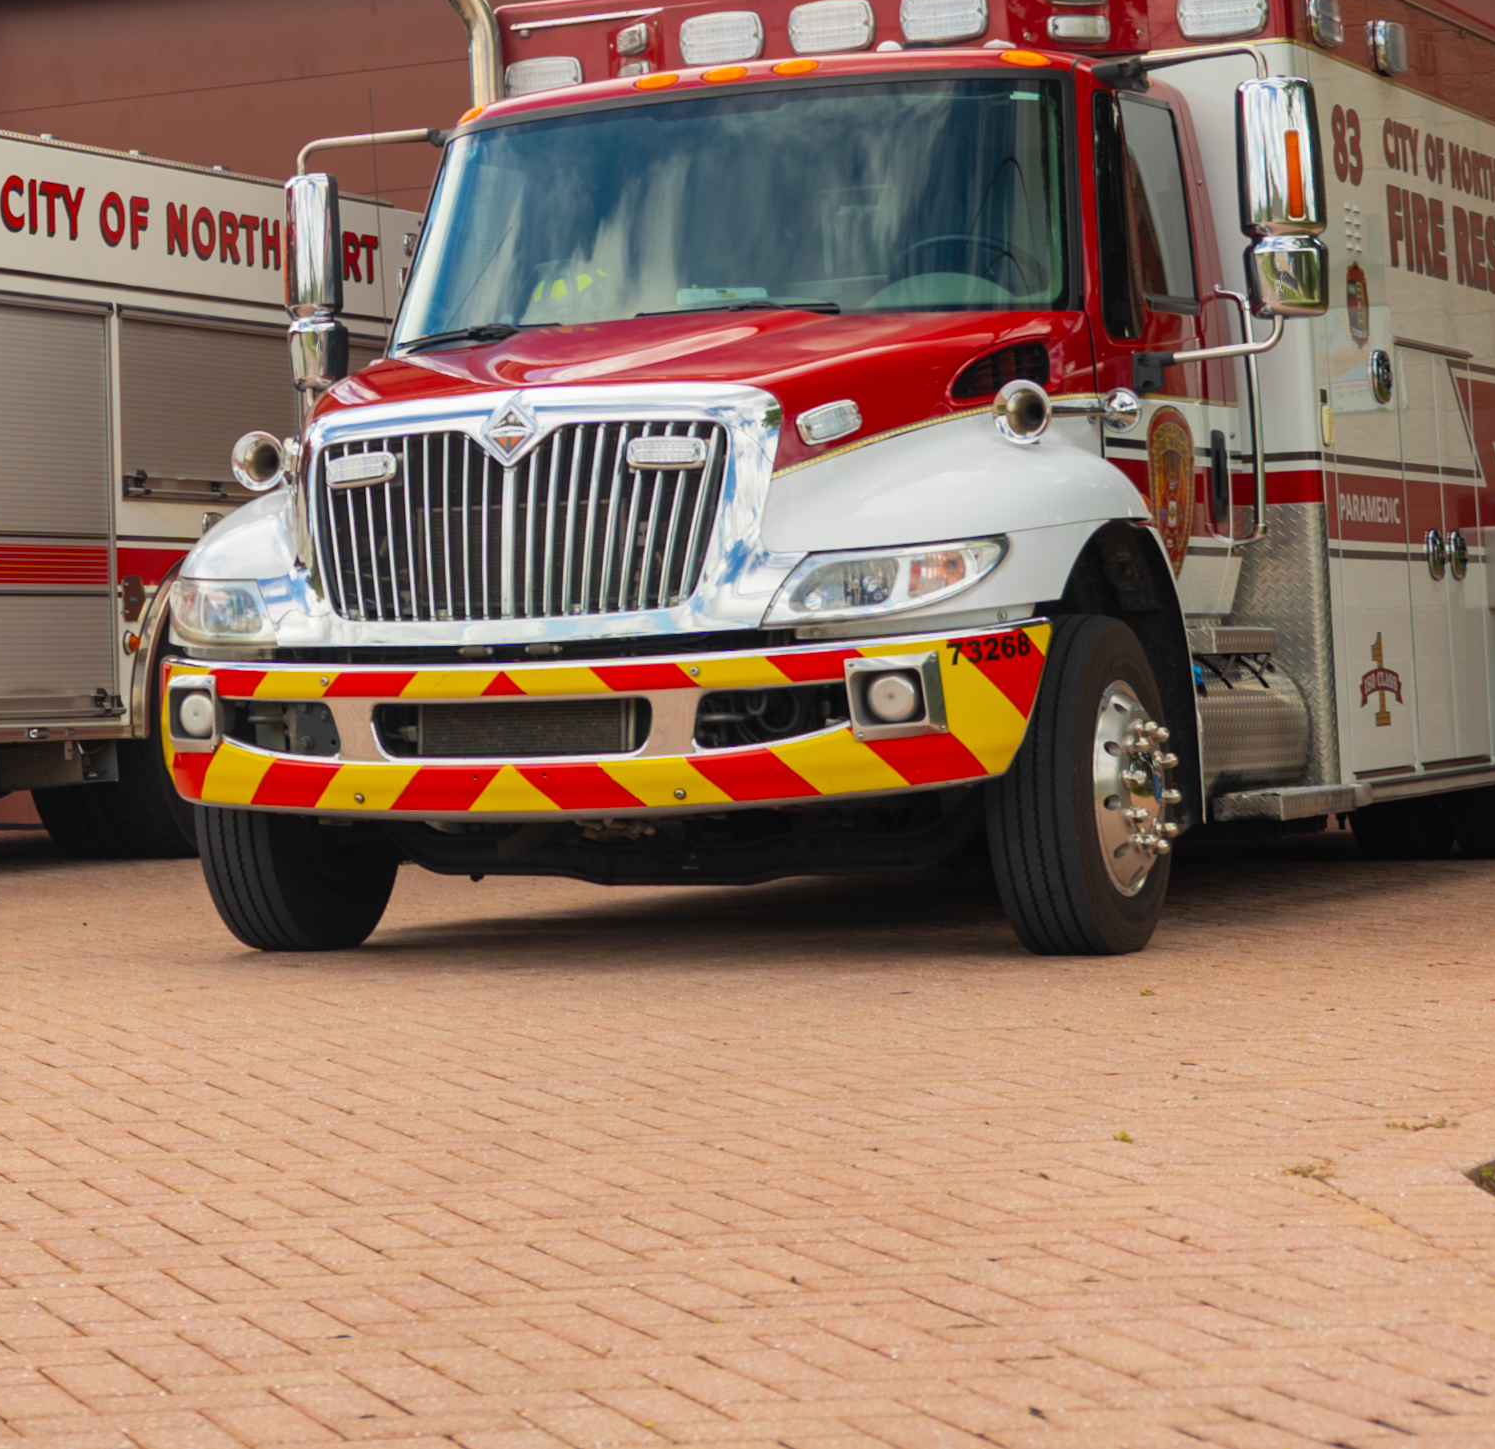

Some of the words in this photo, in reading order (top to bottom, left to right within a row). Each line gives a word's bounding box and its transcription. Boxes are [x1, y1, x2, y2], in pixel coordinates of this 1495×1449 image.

[1331, 104, 1363, 187] 83
[1383, 117, 1419, 177] CITY
[1424, 133, 1445, 185] OF
[0, 174, 85, 241] CITY
[99, 191, 150, 250] OF
[166, 201, 282, 271] NORTH
[342, 231, 379, 285] RT
[1386, 183, 1449, 282] FIRE
[1339, 493, 1401, 525] PARAMEDIC
[946, 632, 1031, 666] 73268
[1364, 673, 1376, 695] ISO
[1377, 671, 1399, 693] CLASS
